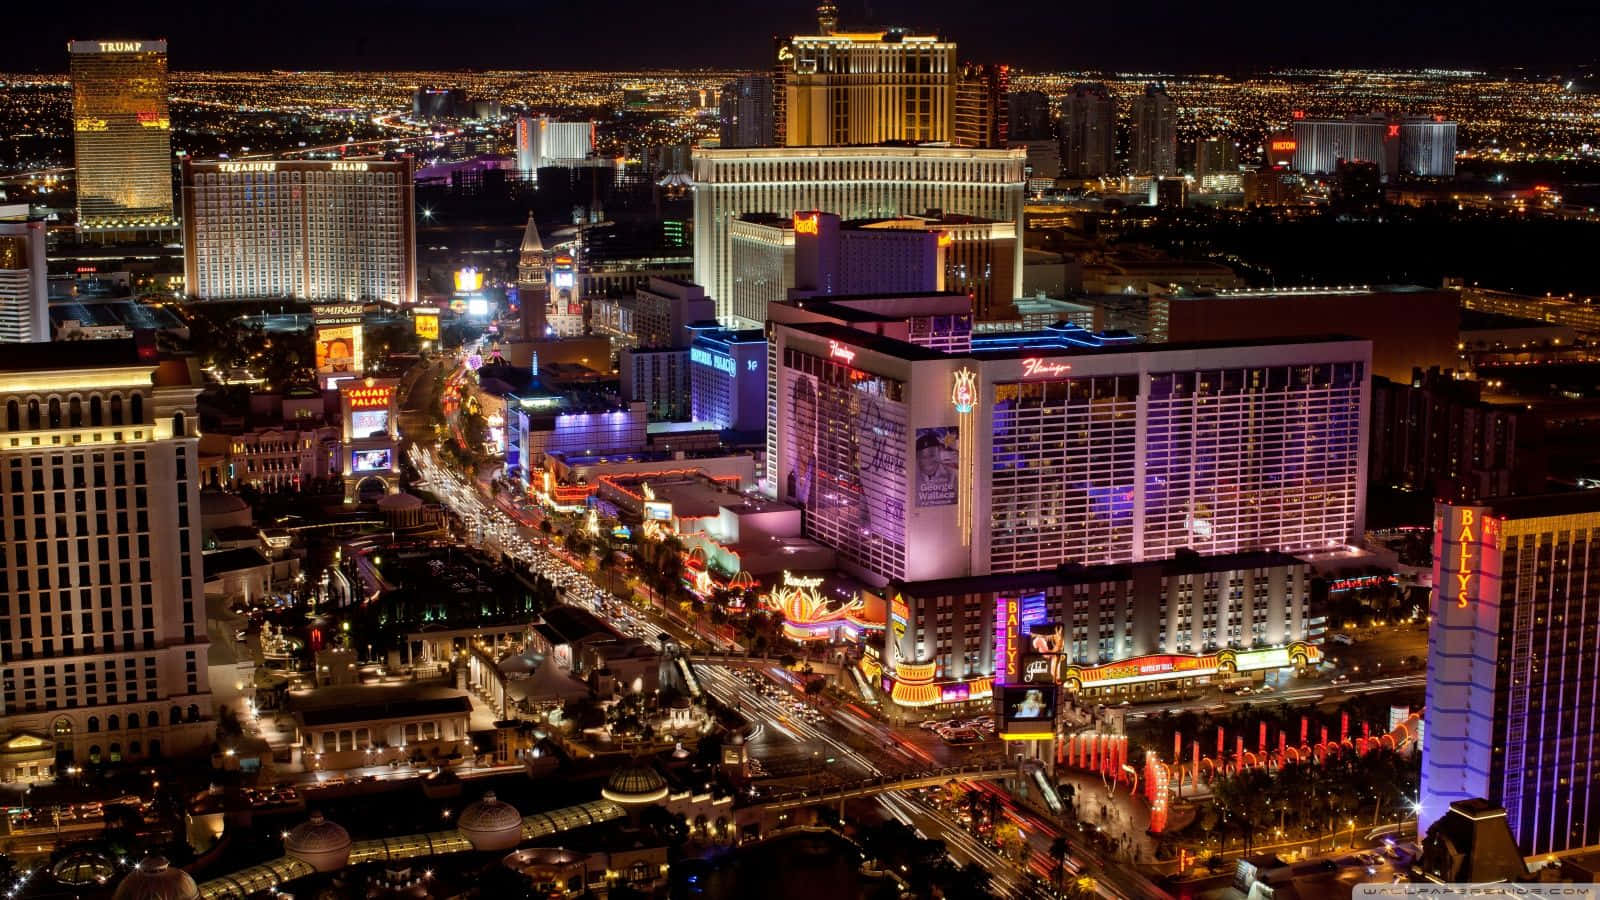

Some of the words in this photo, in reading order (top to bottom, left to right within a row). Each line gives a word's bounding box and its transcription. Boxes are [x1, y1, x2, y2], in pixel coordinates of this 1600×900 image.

[99, 42, 141, 52] TRUMP
[1273, 141, 1296, 150] HILTON
[218, 163, 276, 172] TREASURE
[331, 163, 368, 171] ISLAND
[325, 305, 363, 315] MIRAGE
[1022, 357, 1072, 377] Flamingo
[349, 389, 389, 397] CAESARS
[351, 398, 388, 406] PALACE
[920, 483, 953, 493] George
[919, 491, 955, 500] Wallace
[1457, 509, 1473, 608] BALLYS
[1007, 602, 1017, 675] BALLYS
